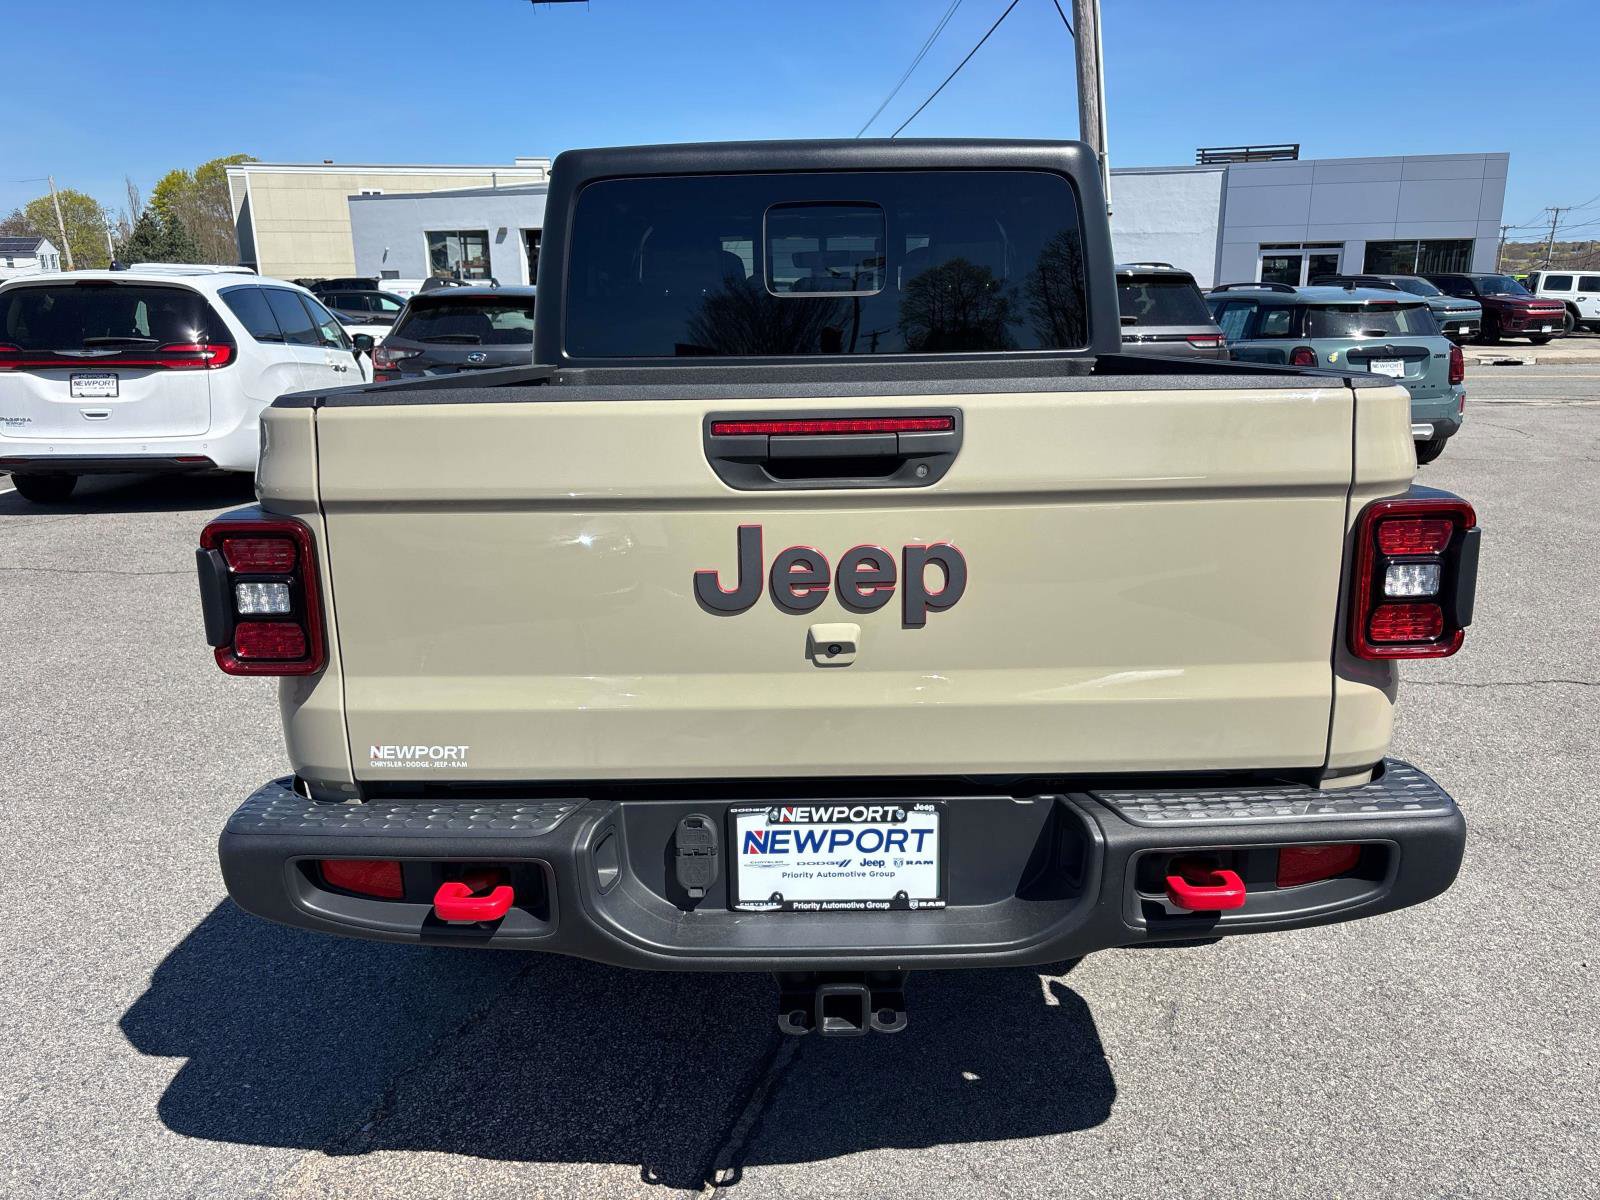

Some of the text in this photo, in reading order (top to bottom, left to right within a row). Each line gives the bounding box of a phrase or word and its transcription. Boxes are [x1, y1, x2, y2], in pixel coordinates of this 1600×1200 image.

[694, 524, 968, 629] Jeep
[369, 745, 469, 759] NEWPORT
[913, 803, 935, 811] Jeep
[779, 806, 899, 822] NEWPORT
[743, 829, 934, 854] NEWPORT
[859, 858, 886, 868] Jeep
[782, 871, 814, 879] Priority
[816, 870, 867, 878] Automotive
[793, 902, 821, 911] Priority
[866, 901, 890, 909] Group
